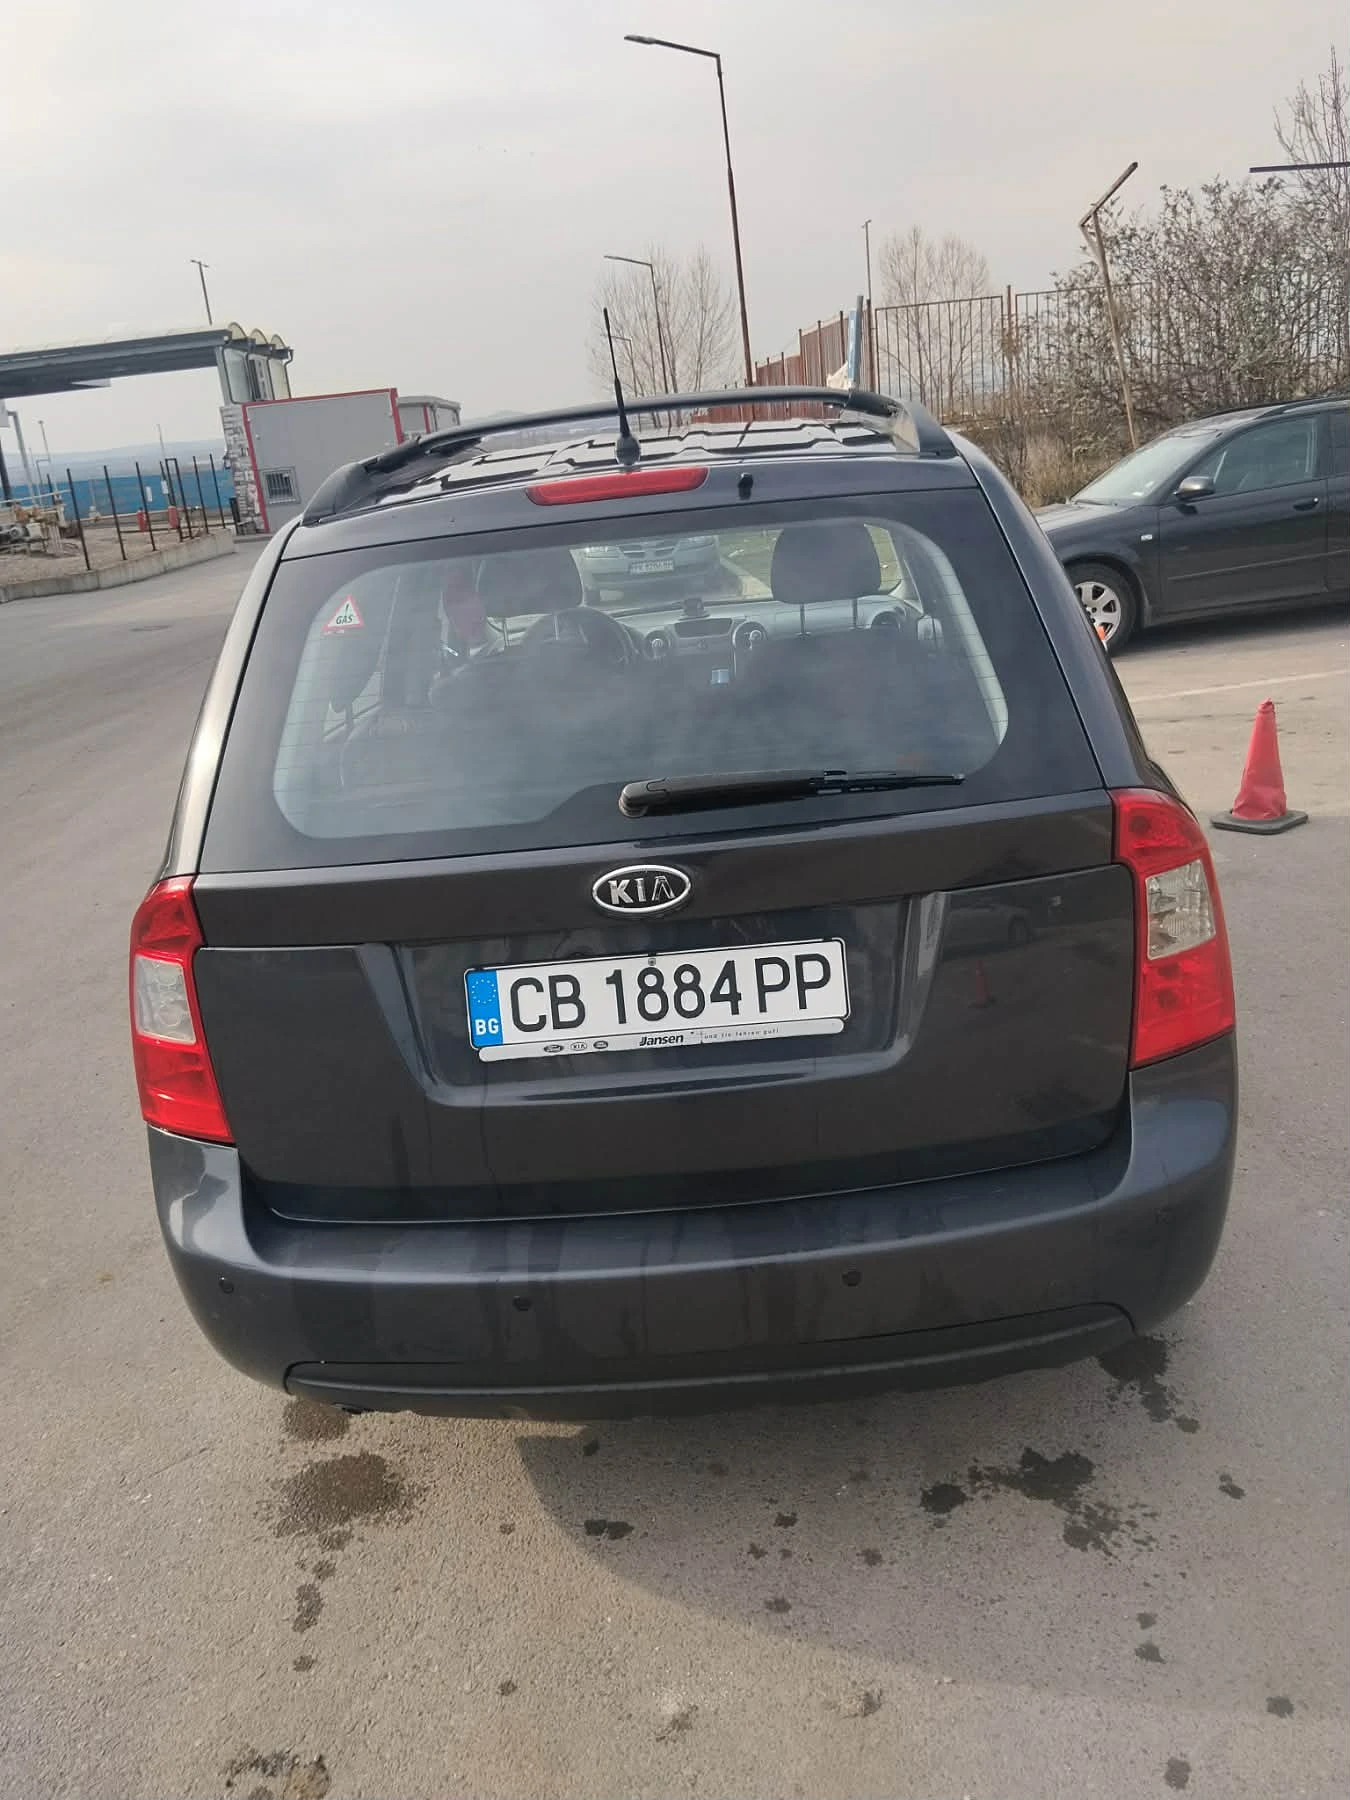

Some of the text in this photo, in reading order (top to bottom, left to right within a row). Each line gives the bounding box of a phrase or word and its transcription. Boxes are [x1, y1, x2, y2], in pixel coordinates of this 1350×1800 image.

[336, 615, 353, 625] GAS
[607, 875, 675, 905] KIA
[509, 953, 832, 1033] CB 1884 PP
[475, 1017, 499, 1036] BG
[639, 1034, 684, 1047] Jansen
